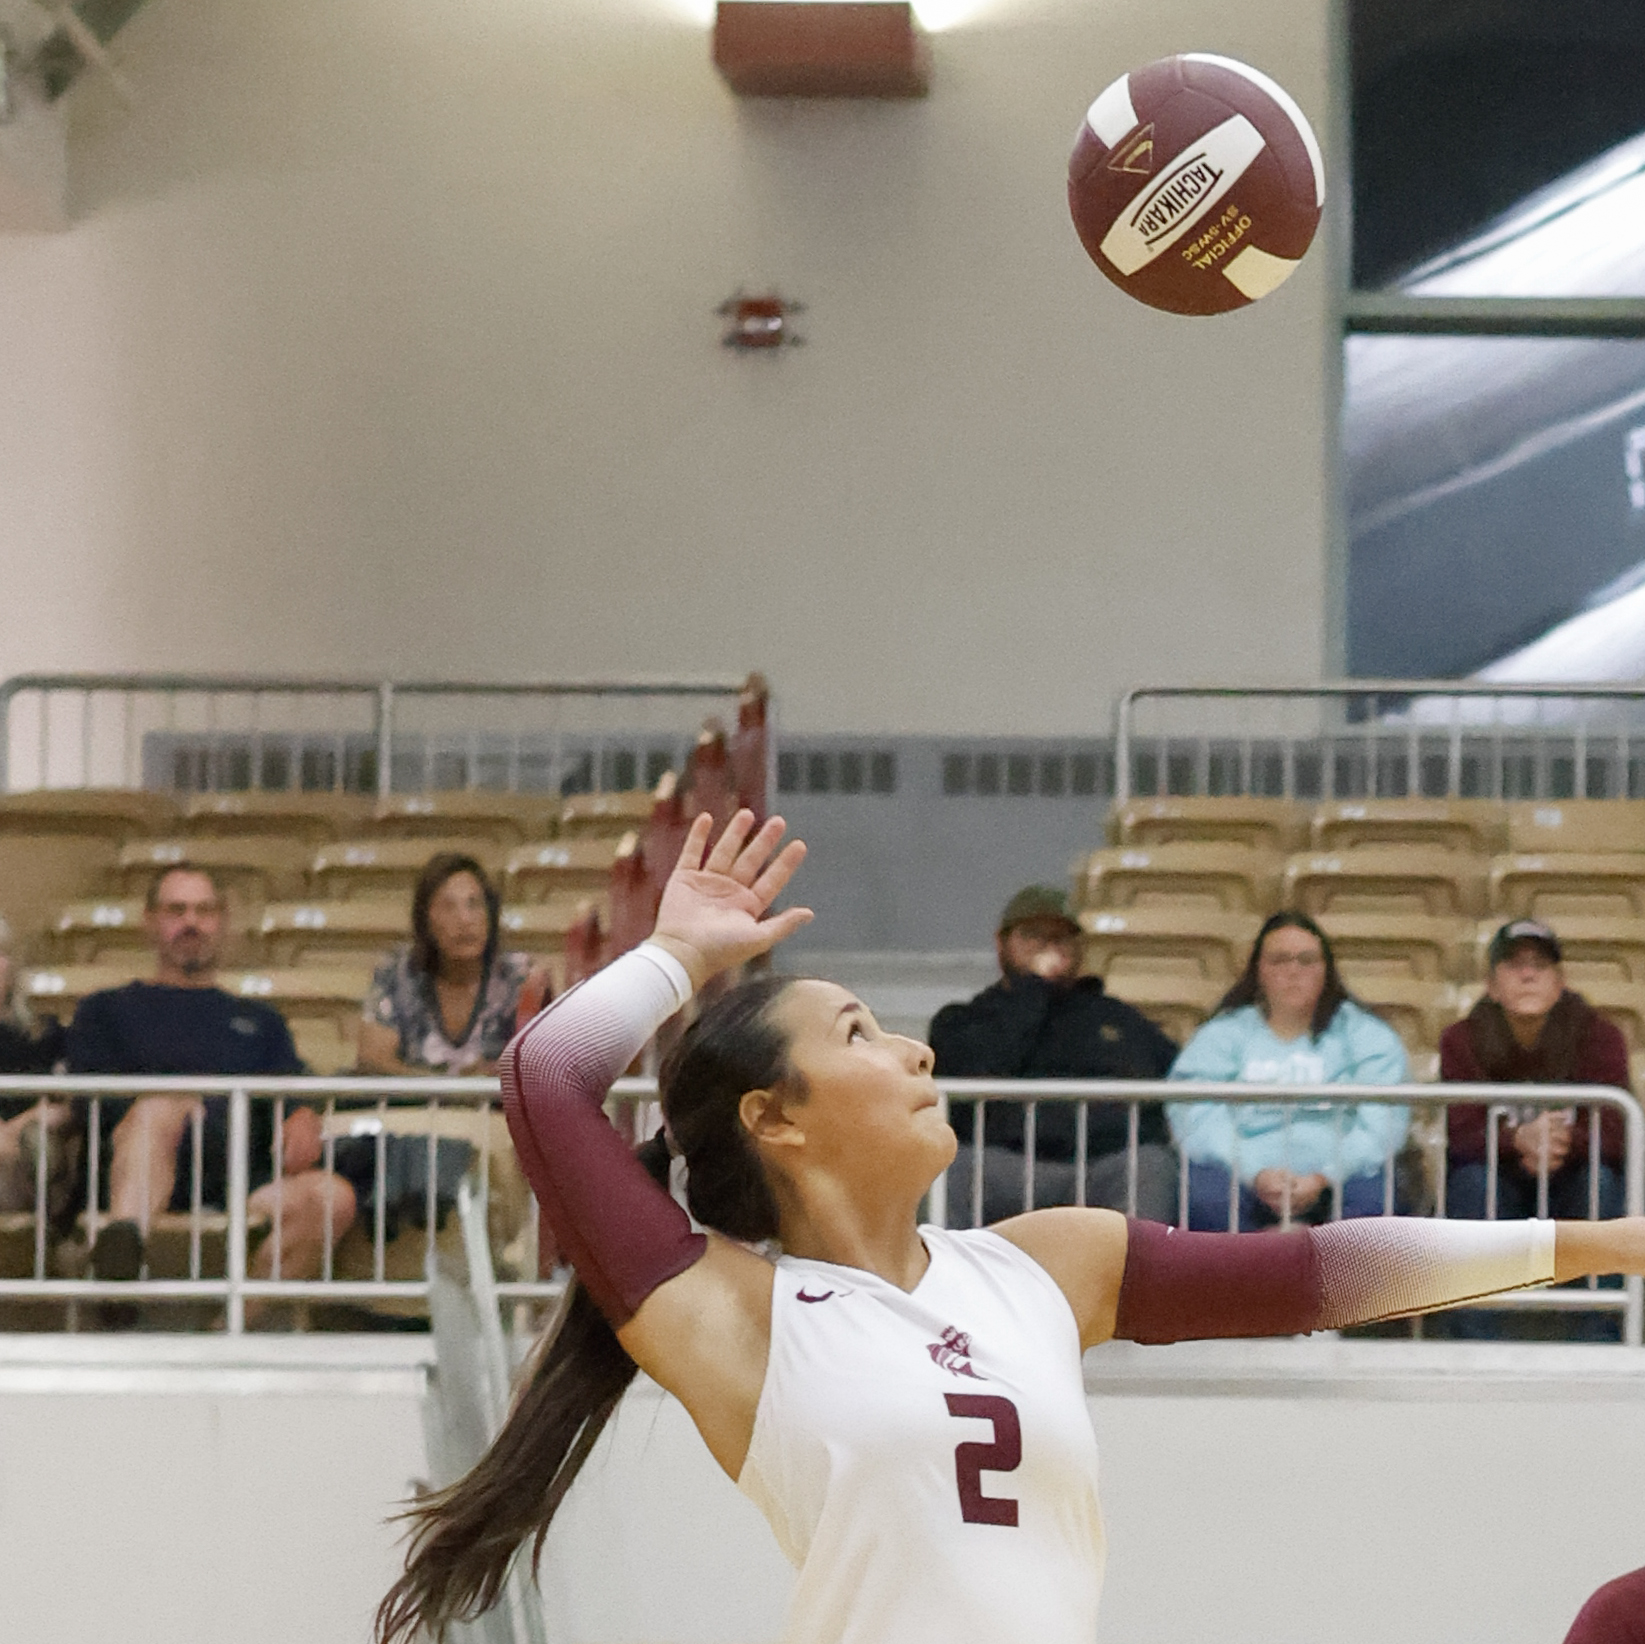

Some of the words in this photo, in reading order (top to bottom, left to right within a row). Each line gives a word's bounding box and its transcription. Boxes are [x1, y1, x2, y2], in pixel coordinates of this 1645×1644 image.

[1138, 162, 1224, 237] TACHIKARA
[1192, 214, 1252, 270] OFFICIAL
[943, 1392, 1022, 1528] 2
